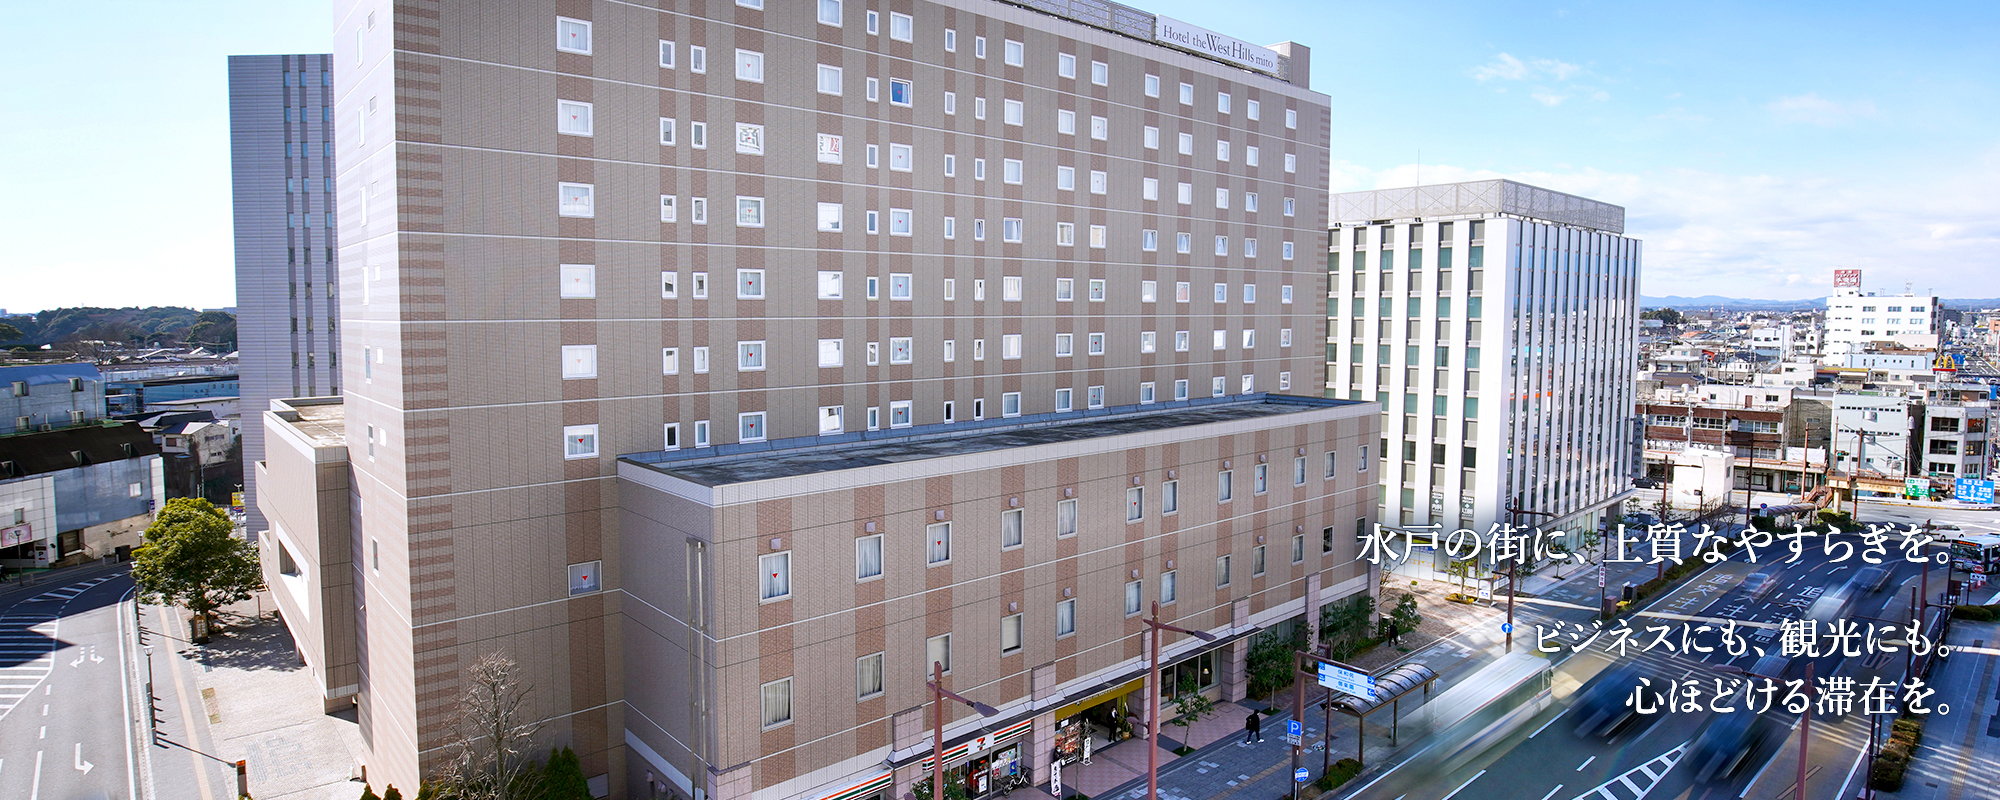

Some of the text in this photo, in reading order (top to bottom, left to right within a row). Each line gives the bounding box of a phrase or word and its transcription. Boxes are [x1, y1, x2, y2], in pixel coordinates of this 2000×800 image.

[1163, 24, 1190, 44] Hotel
[1205, 33, 1231, 56] West
[1231, 41, 1255, 63] Hills
[1255, 54, 1274, 69] mito
[1632, 427, 1642, 474] 水戸信用金庫
[1290, 722, 1299, 733] P
